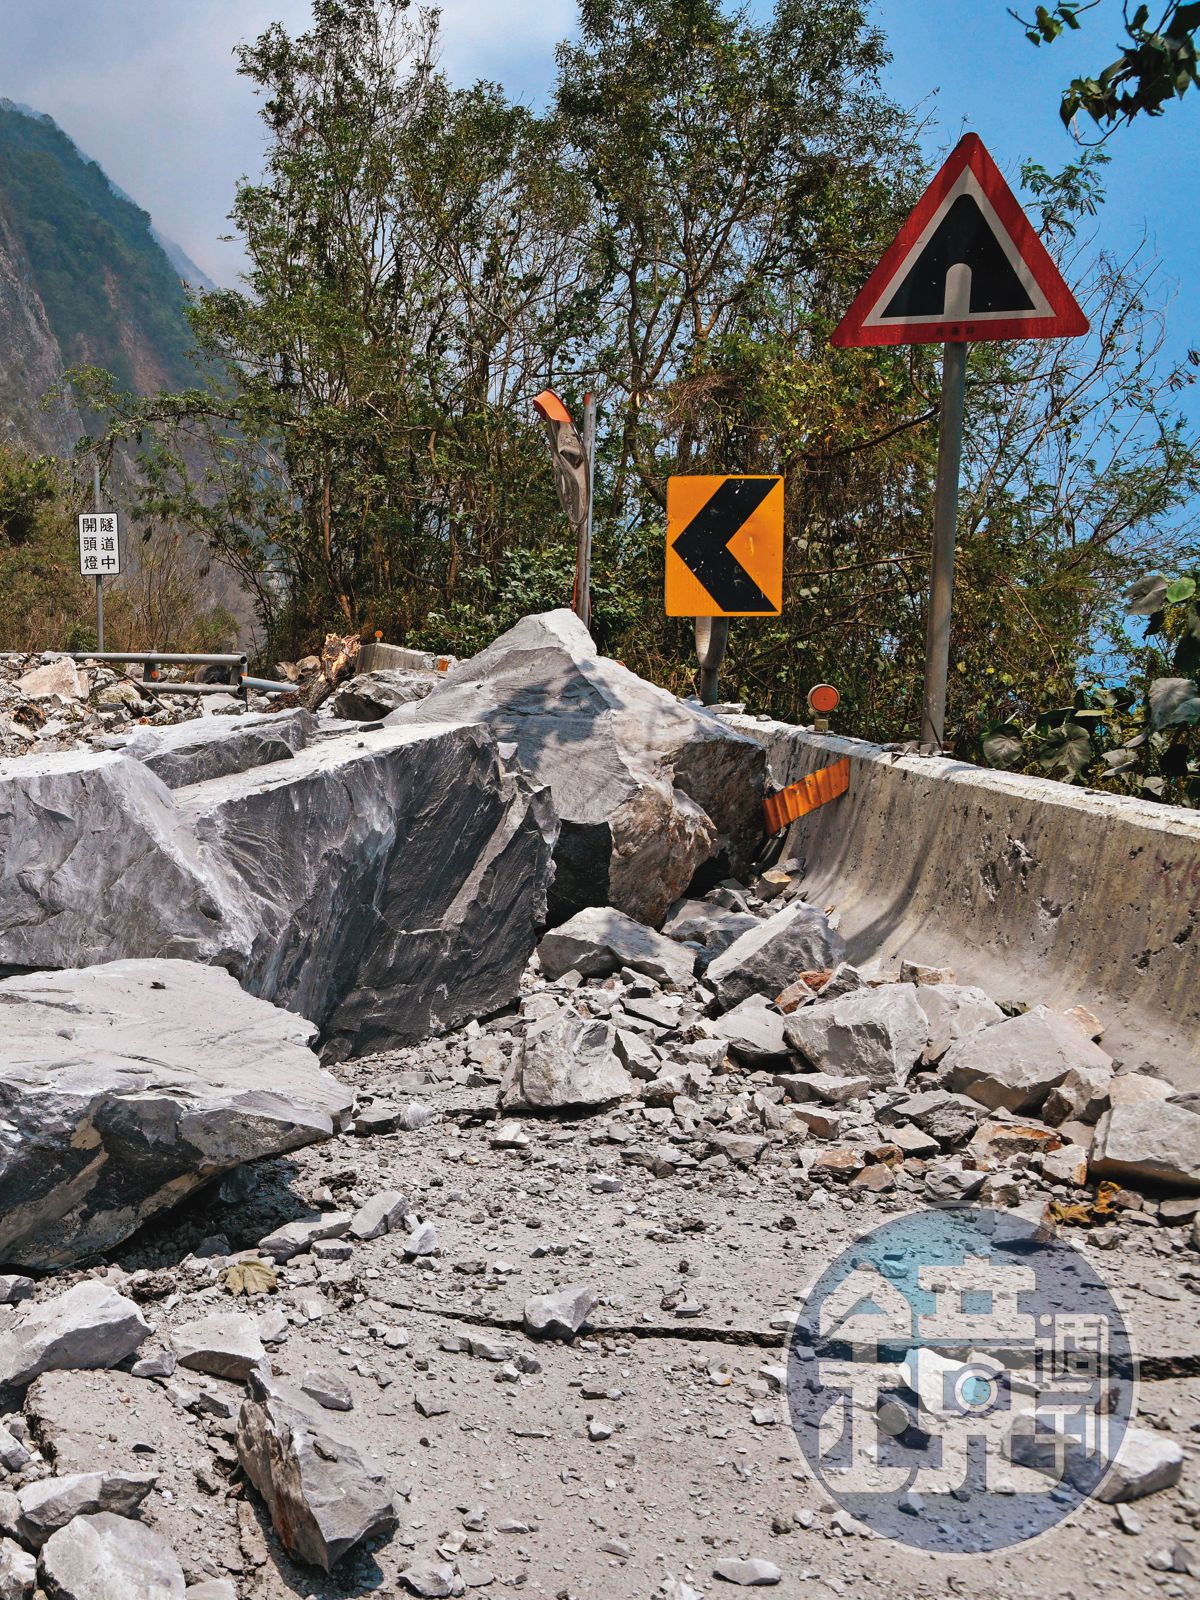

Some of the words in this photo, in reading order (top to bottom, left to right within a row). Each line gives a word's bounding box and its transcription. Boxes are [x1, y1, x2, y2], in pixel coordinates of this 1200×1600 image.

[82, 517, 99, 570] 開頭燈
[100, 517, 116, 570] 隧道中
